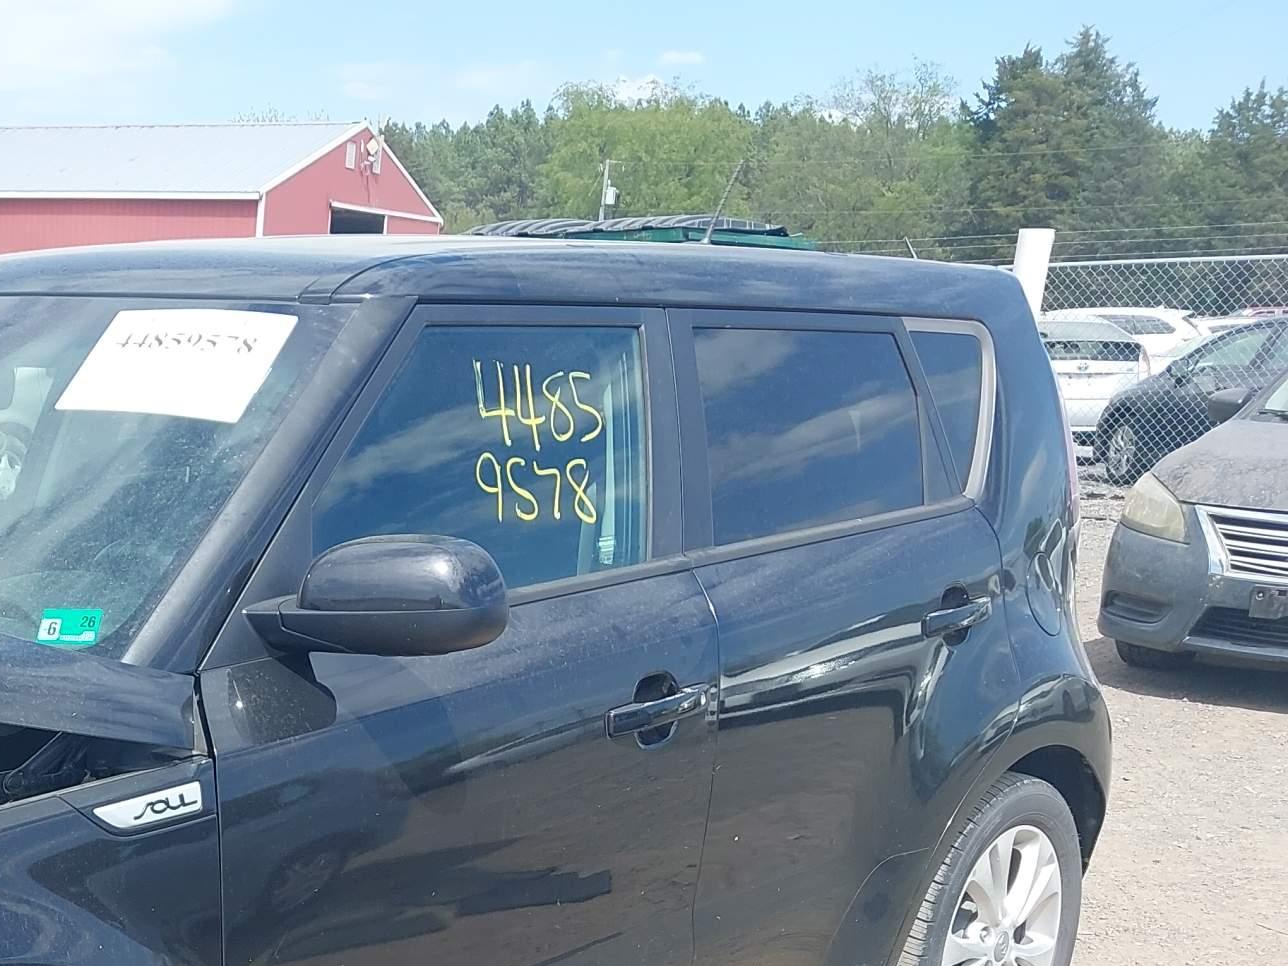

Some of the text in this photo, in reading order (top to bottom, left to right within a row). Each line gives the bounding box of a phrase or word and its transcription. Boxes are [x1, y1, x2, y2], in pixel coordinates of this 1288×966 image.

[472, 359, 604, 452] 4485
[475, 451, 597, 524] 9578
[47, 621, 58, 636] 6
[80, 615, 97, 628] 26
